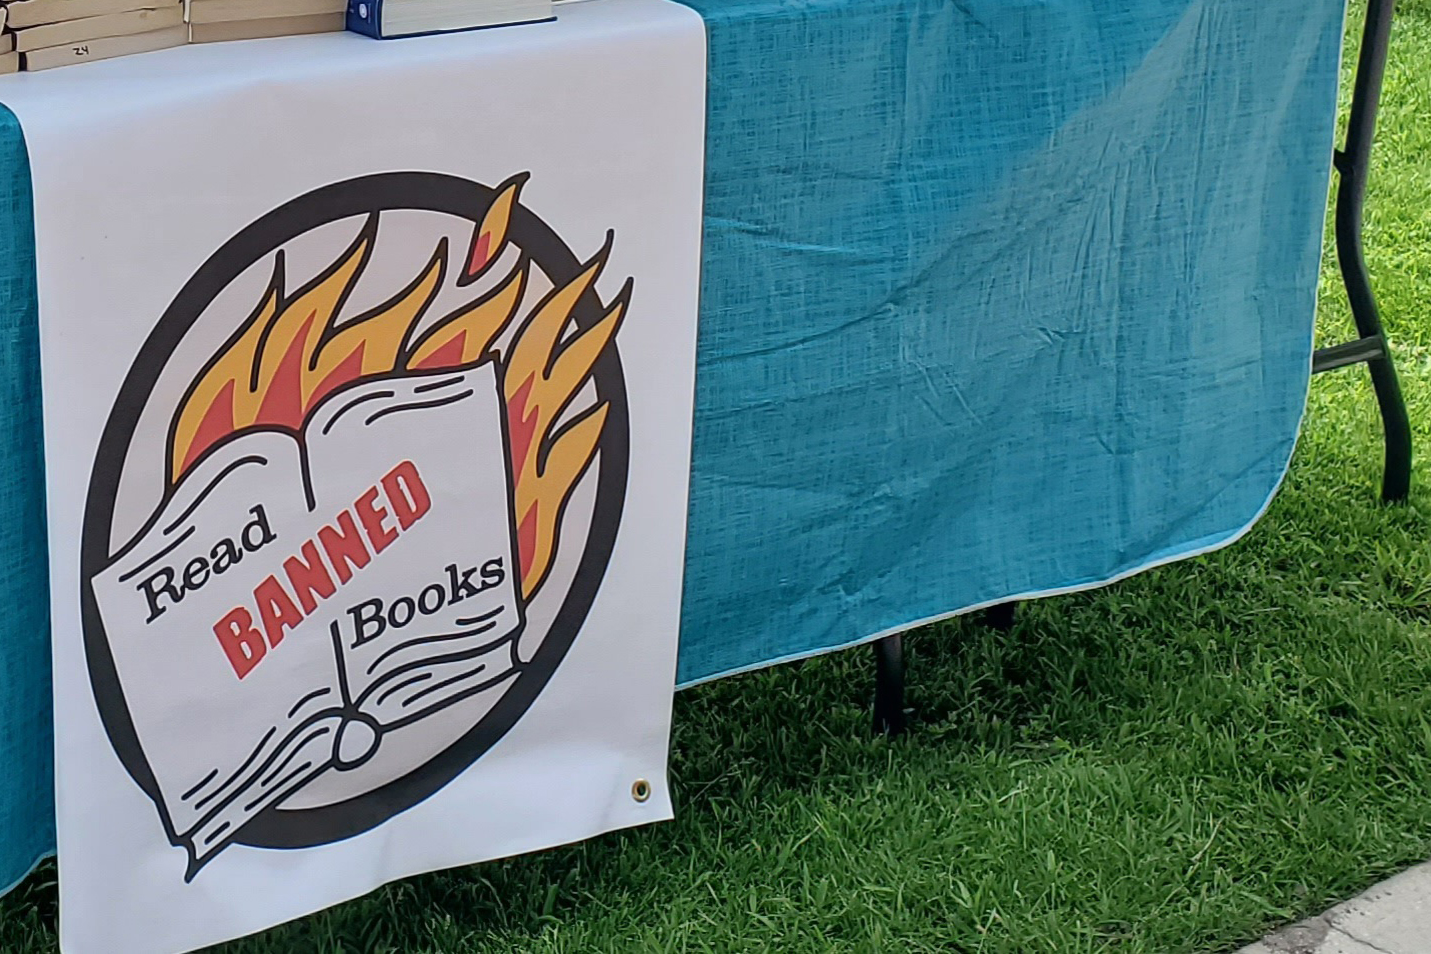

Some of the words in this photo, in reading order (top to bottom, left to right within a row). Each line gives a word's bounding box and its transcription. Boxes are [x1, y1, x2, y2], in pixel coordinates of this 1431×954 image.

[135, 504, 278, 624] Read
[212, 458, 434, 680] BANNED
[346, 554, 507, 650] Books
